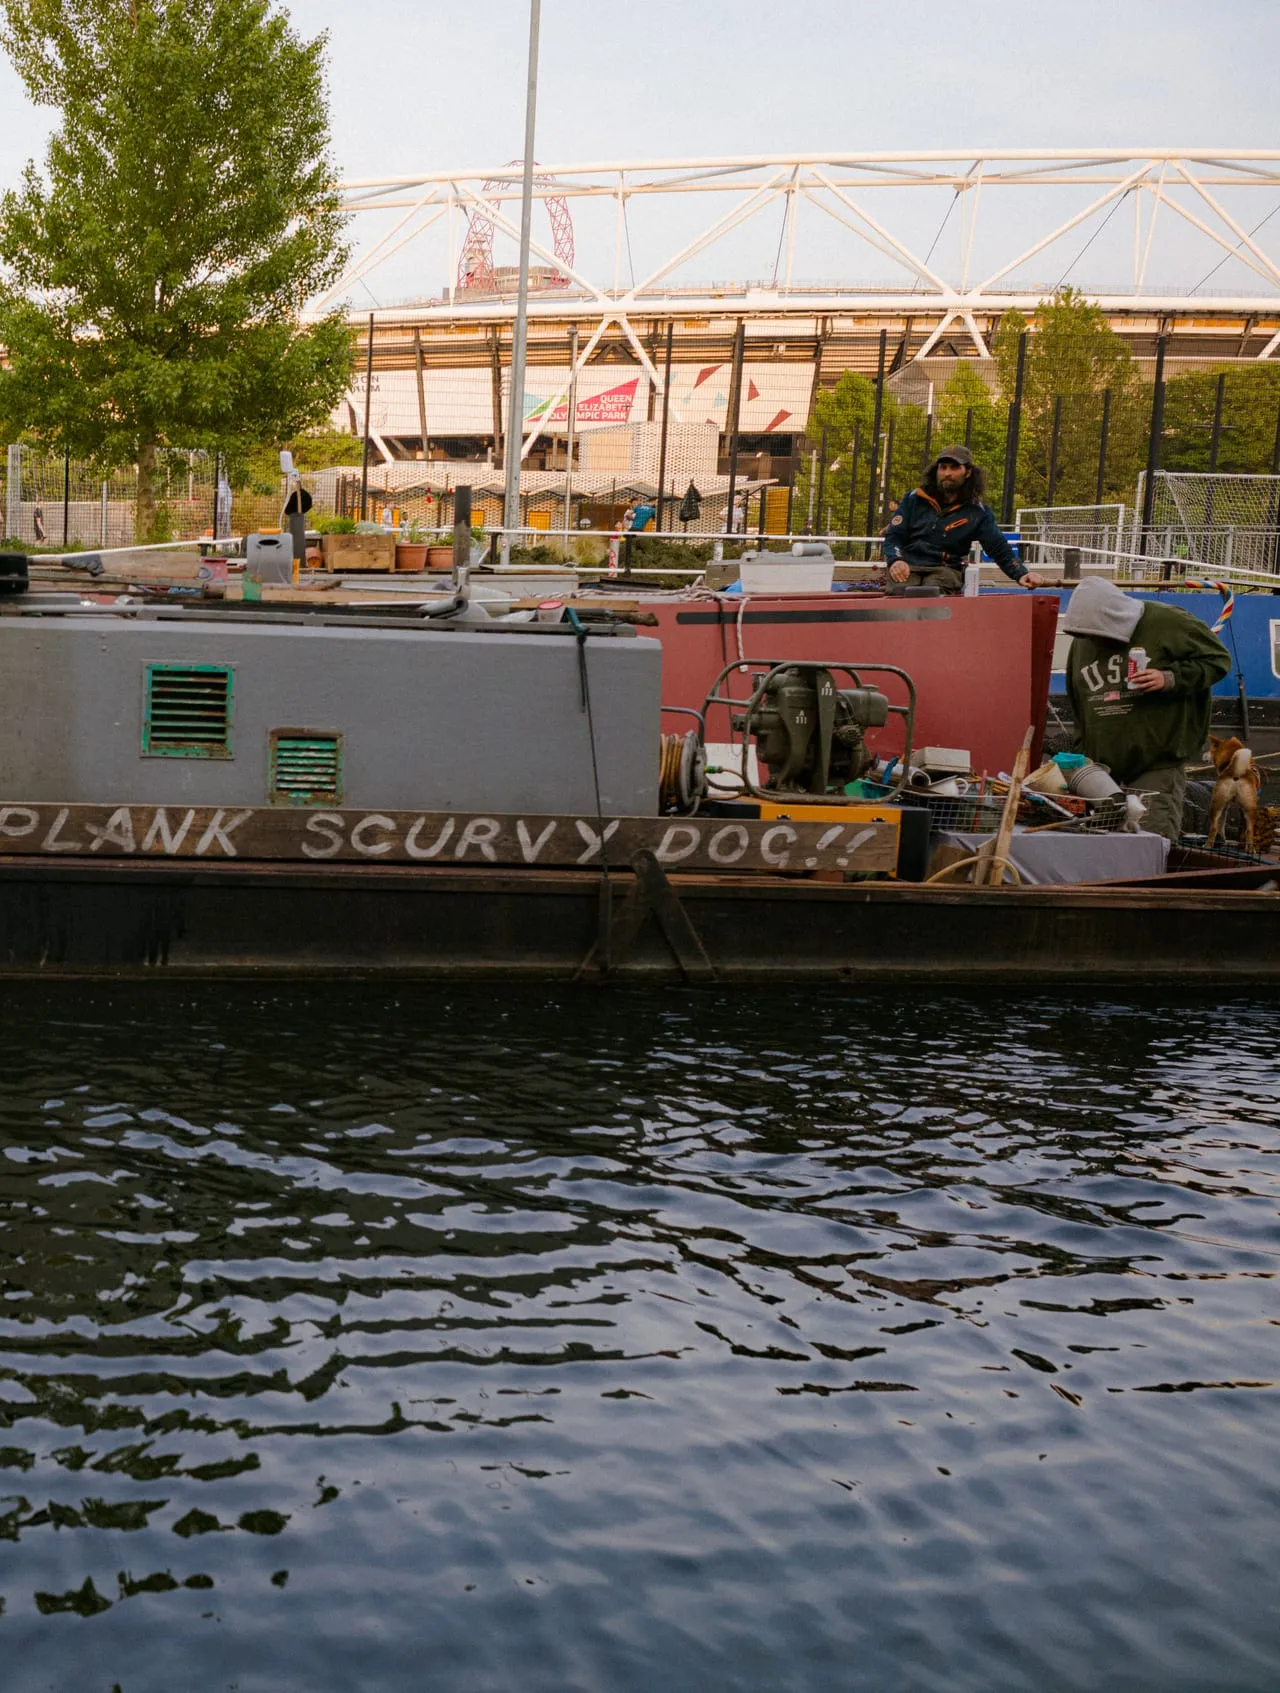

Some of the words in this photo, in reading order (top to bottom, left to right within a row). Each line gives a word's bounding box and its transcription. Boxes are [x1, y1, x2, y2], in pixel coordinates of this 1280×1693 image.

[600, 394, 632, 403] QUEEN
[601, 411, 627, 419] PARK
[1080, 654, 1128, 692] US
[301, 812, 619, 865] SCURVY
[655, 824, 877, 869] DOG!!
